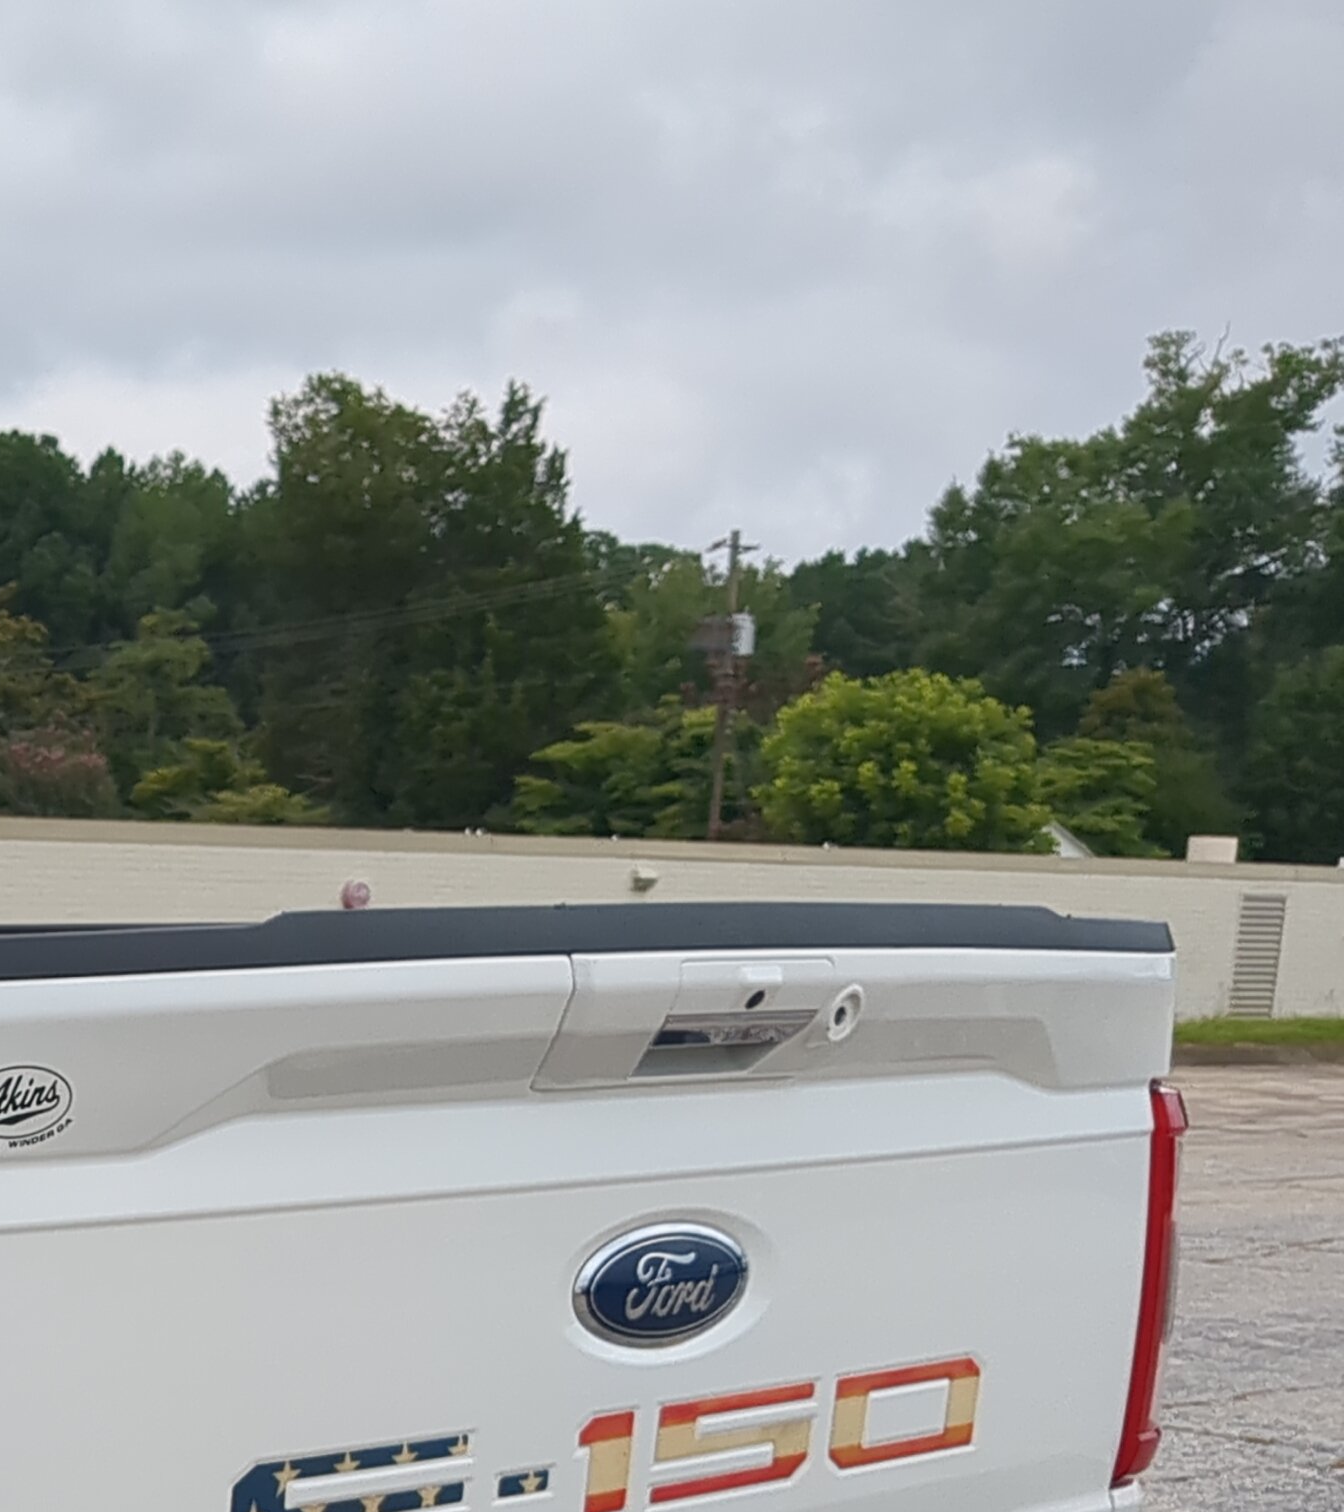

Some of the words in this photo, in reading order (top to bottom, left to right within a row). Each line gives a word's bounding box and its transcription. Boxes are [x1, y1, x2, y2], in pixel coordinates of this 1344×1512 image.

[8, 1129, 54, 1148] WINDER
[56, 1118, 73, 1133] GA
[624, 1251, 719, 1320] Ford
